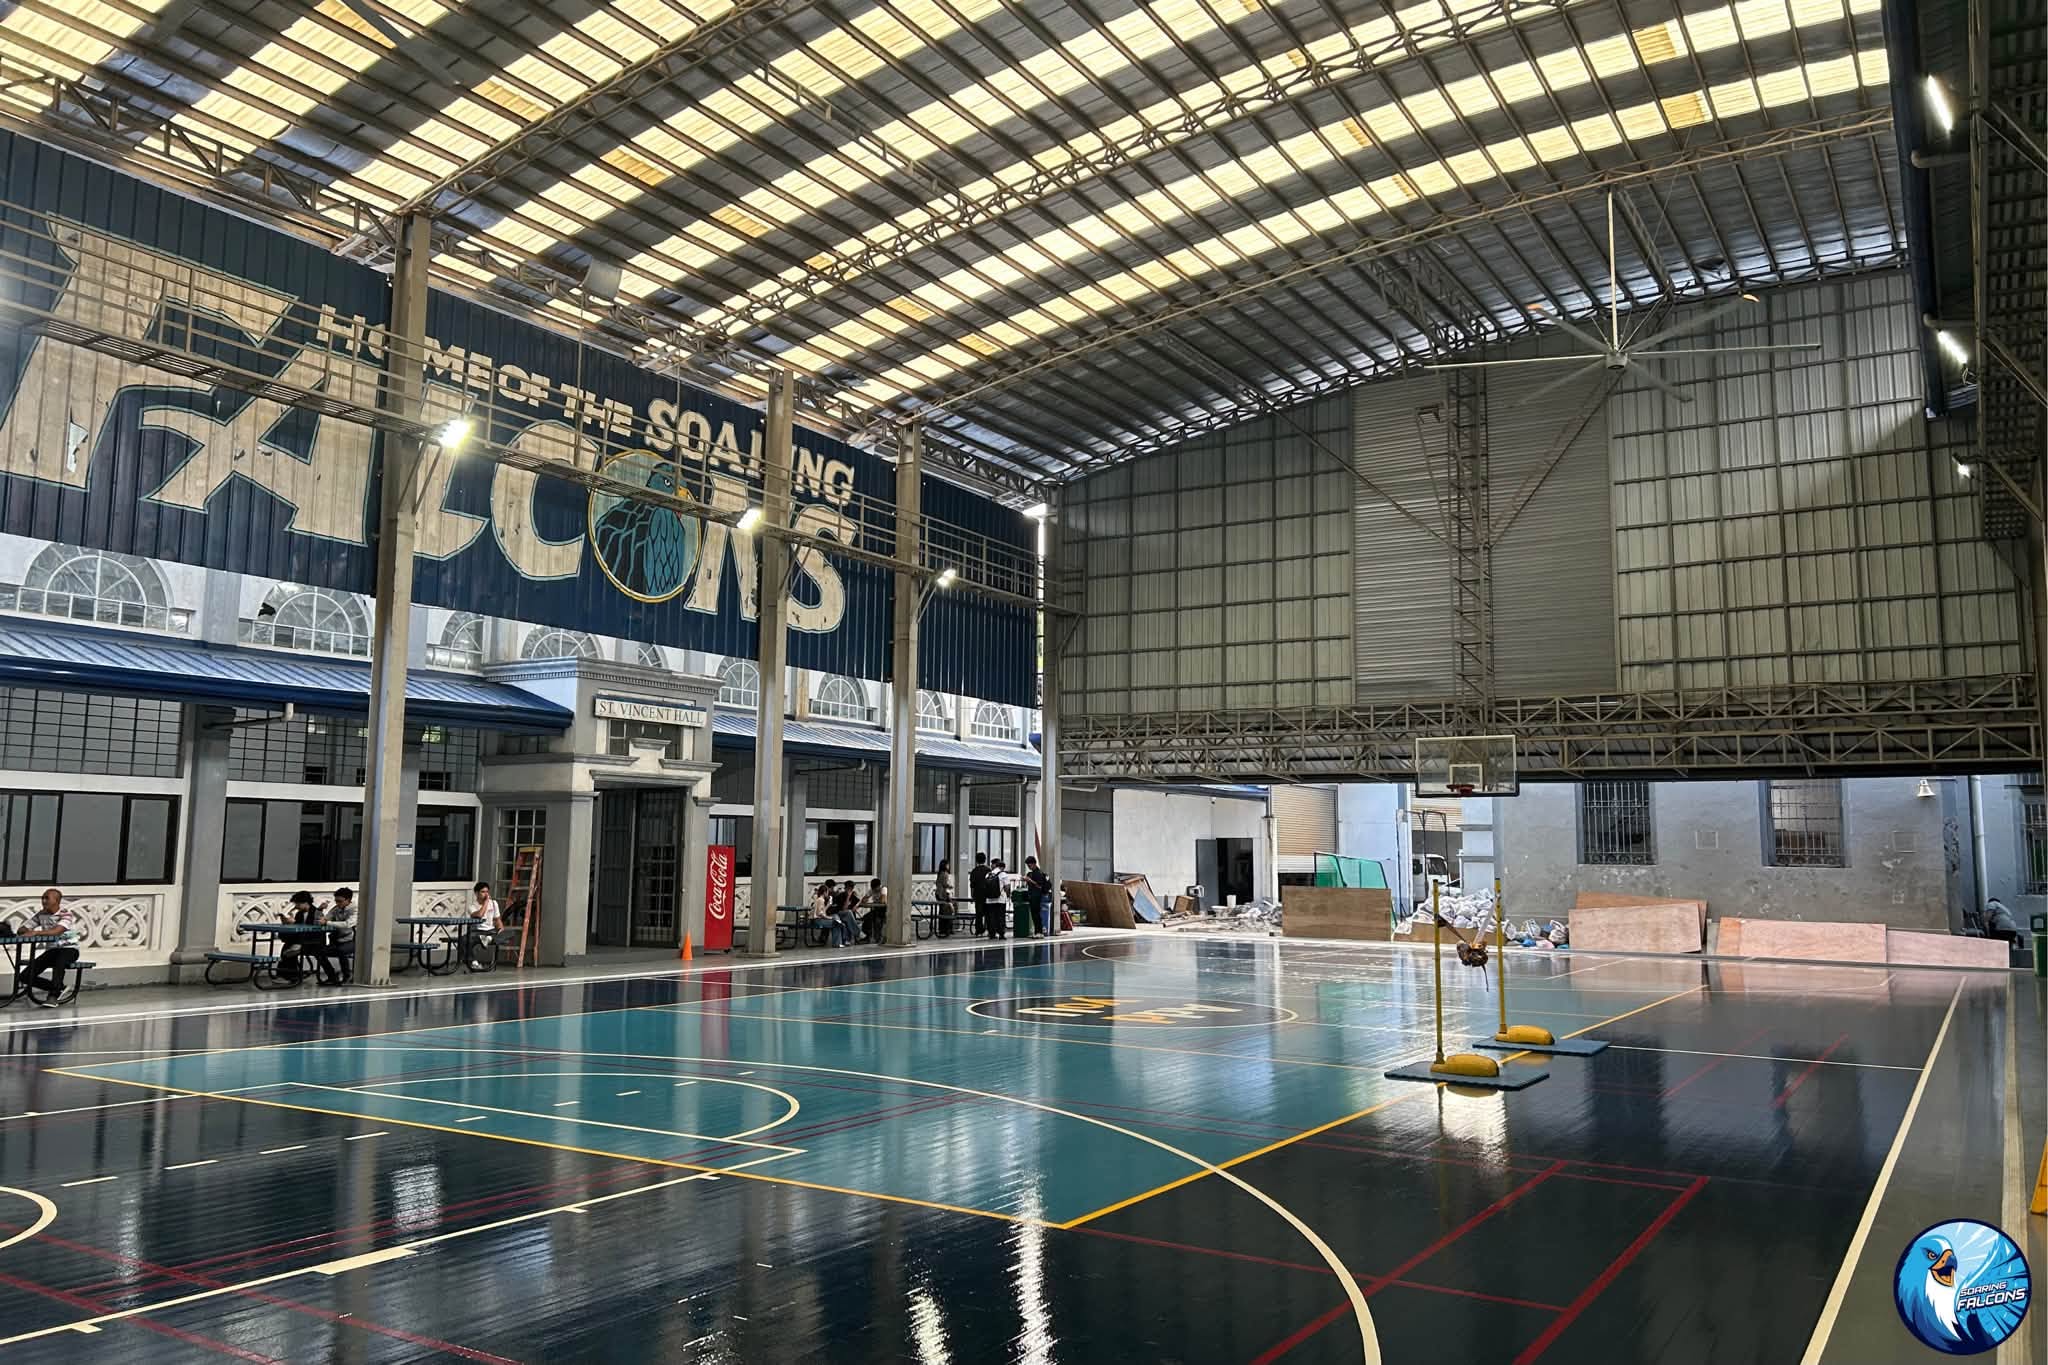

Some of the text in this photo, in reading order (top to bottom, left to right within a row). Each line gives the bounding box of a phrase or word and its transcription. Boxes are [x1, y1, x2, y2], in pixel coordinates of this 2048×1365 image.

[498, 364, 550, 407] OF
[560, 383, 633, 437] THE
[645, 398, 855, 506] SOANG
[600, 702, 703, 724] ST. VINCENT HALL
